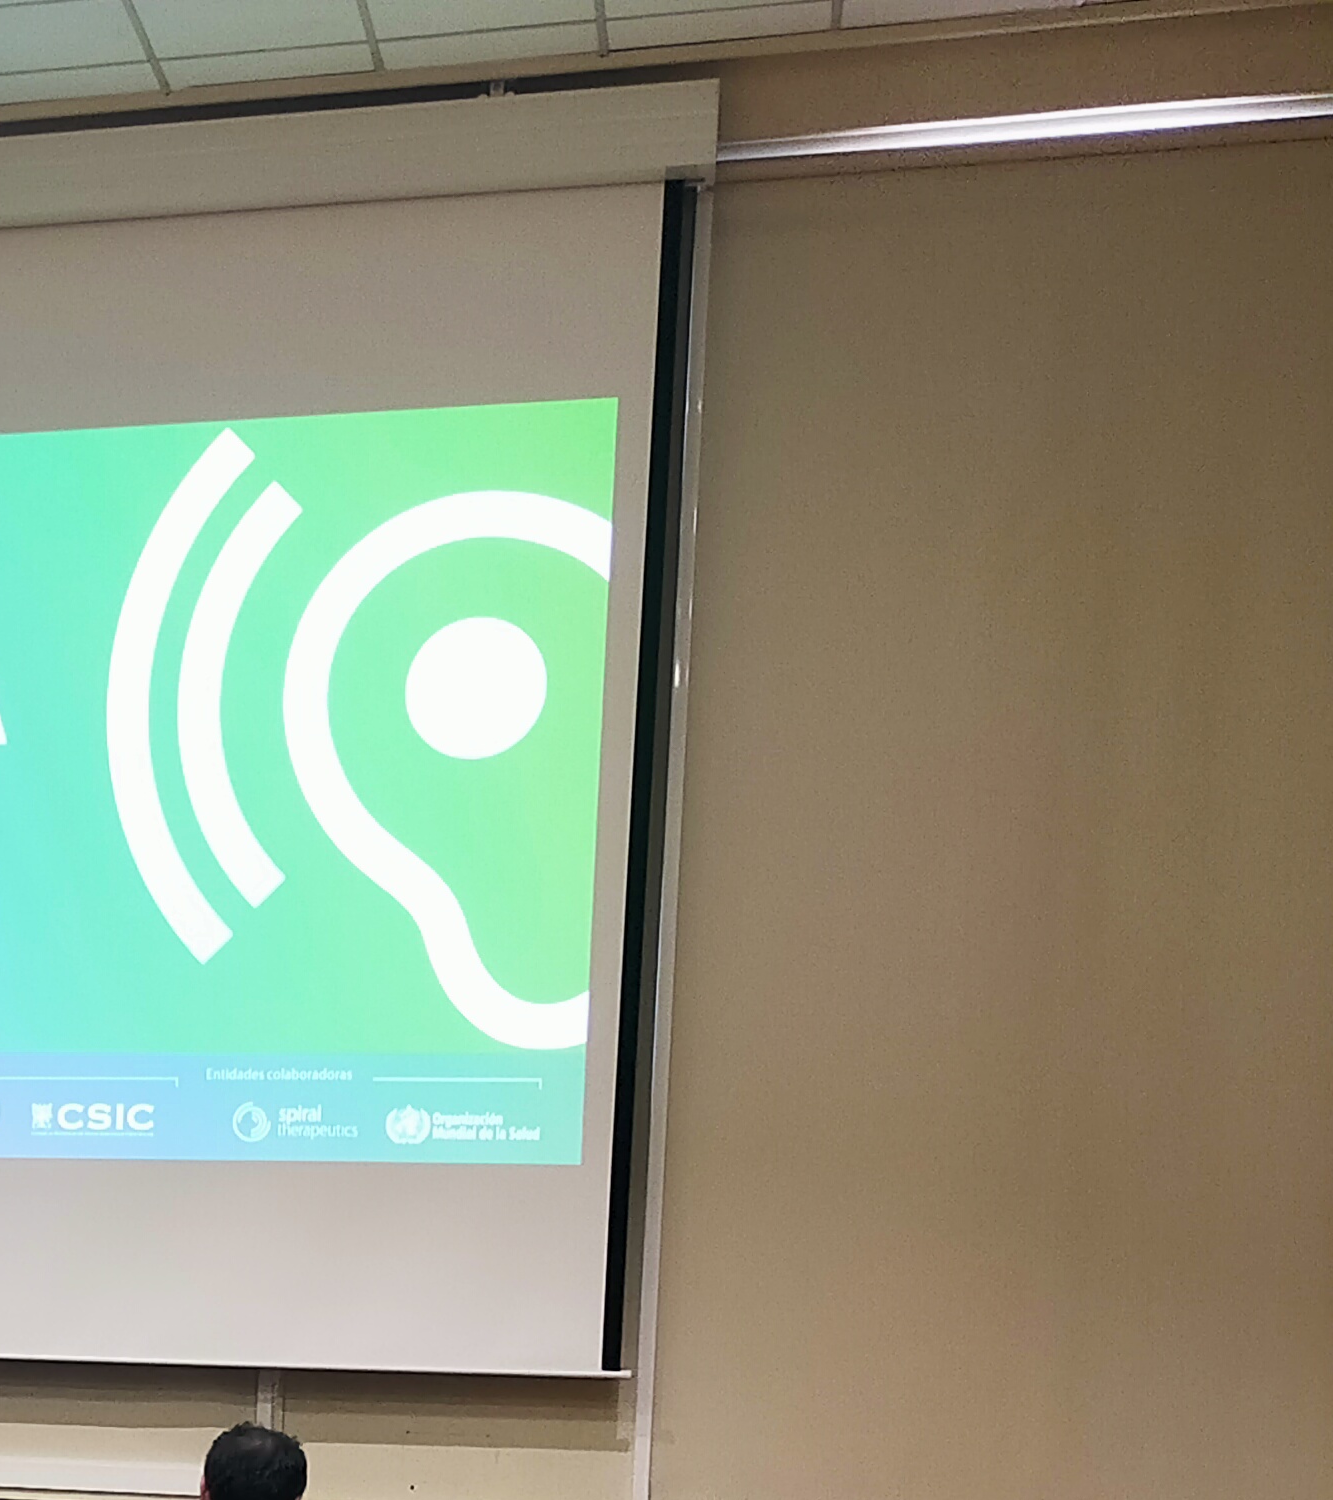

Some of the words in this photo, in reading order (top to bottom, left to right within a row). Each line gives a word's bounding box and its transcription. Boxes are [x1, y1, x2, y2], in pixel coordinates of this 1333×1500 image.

[206, 1068, 264, 1081] Entidades
[266, 1068, 353, 1081] colaboradoras
[57, 1103, 155, 1130] CSIC
[278, 1104, 322, 1123] spiral
[277, 1122, 359, 1139] therapeutics
